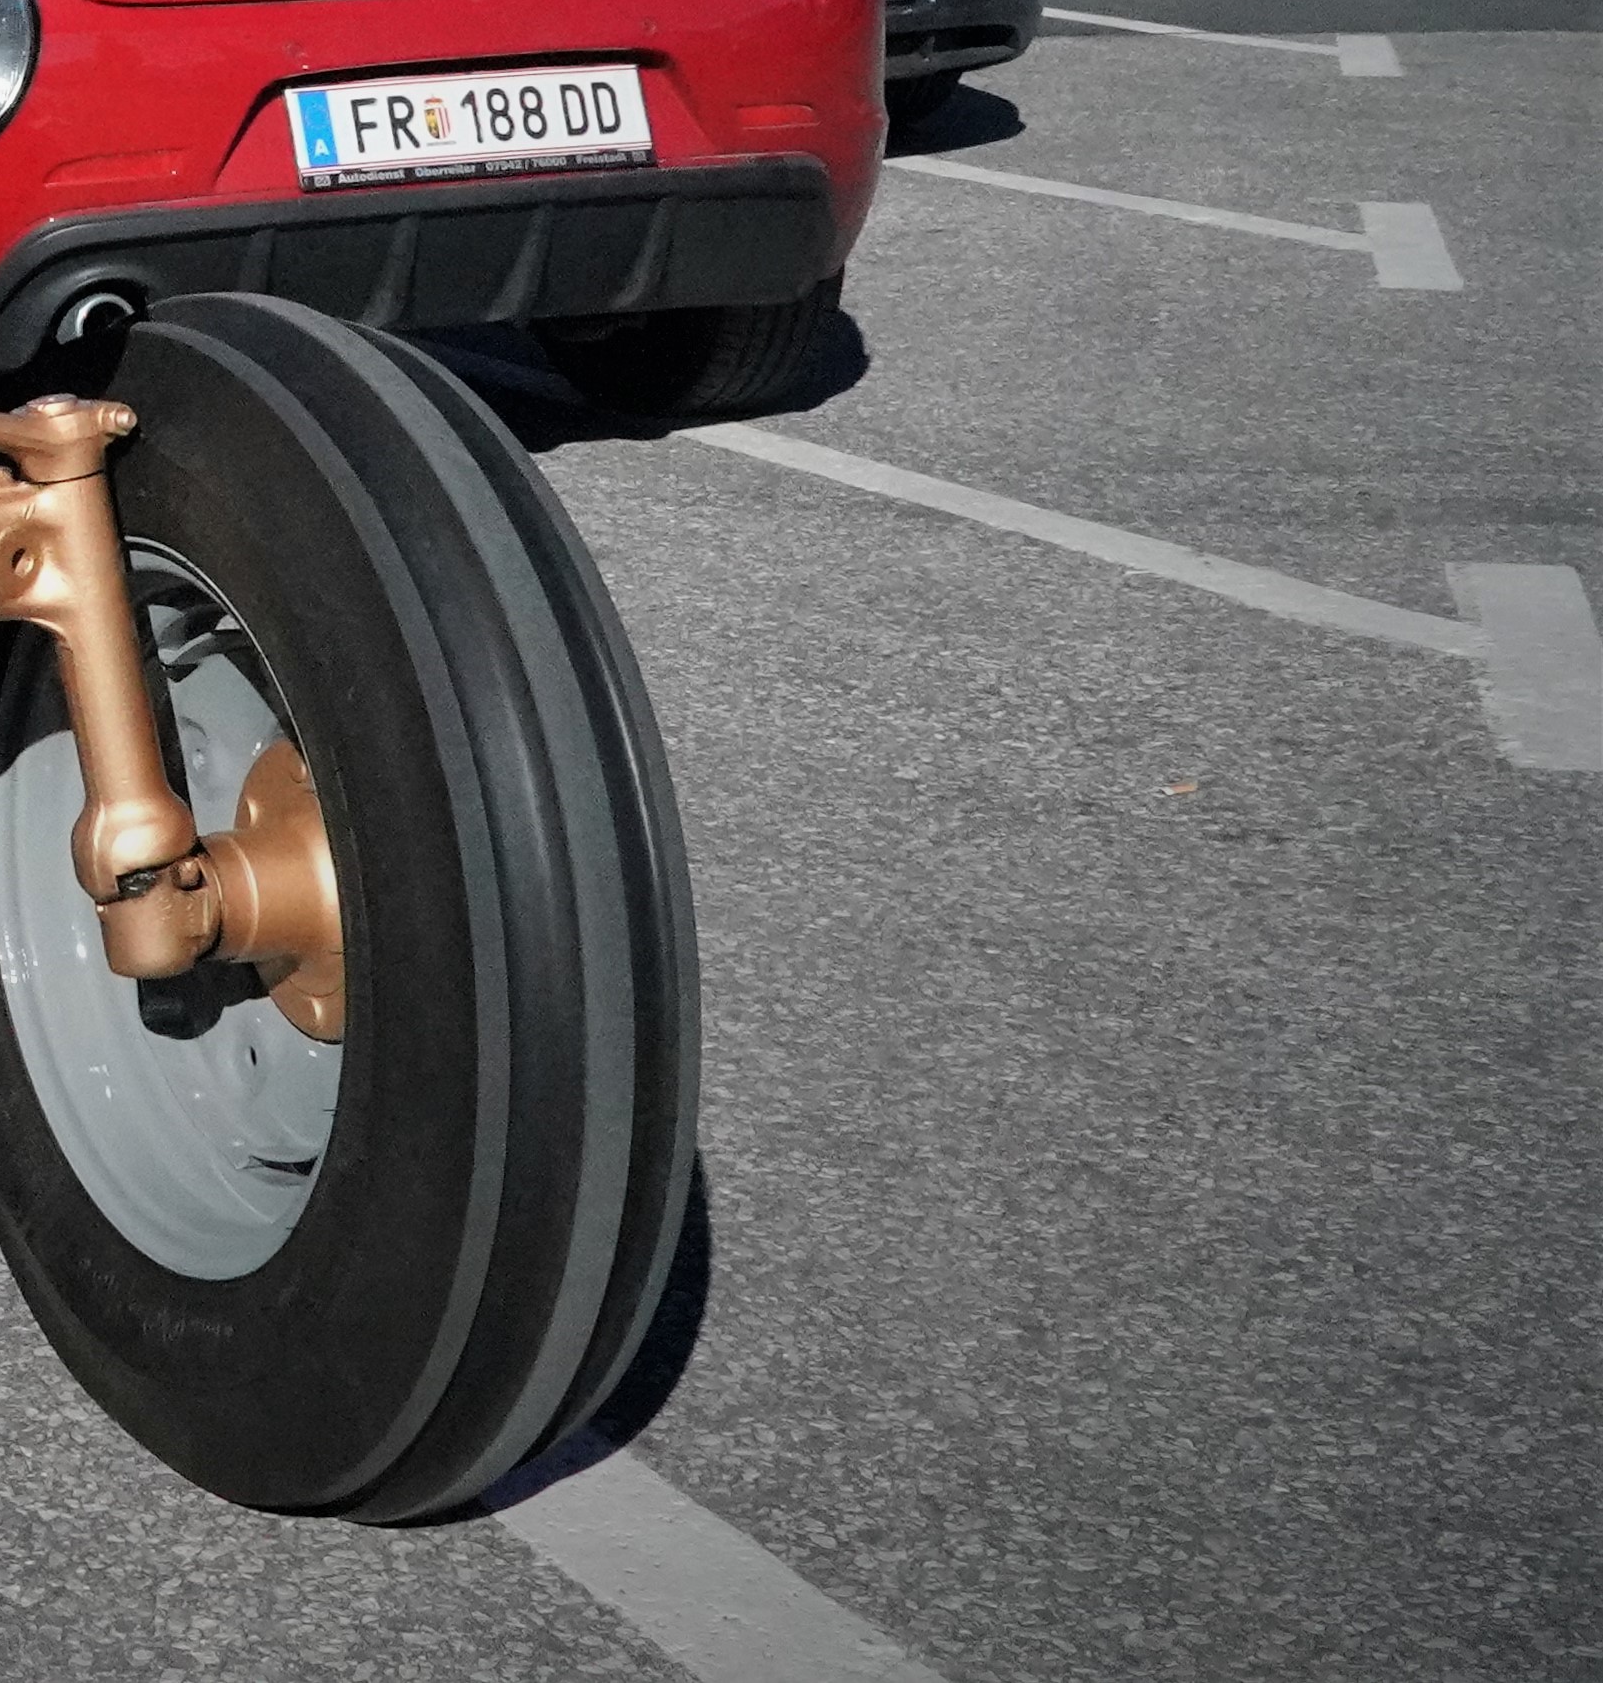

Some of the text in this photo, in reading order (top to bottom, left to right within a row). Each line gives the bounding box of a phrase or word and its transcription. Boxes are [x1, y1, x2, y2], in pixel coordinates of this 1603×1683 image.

[350, 81, 622, 153] FR 188 DD
[313, 139, 330, 156] A
